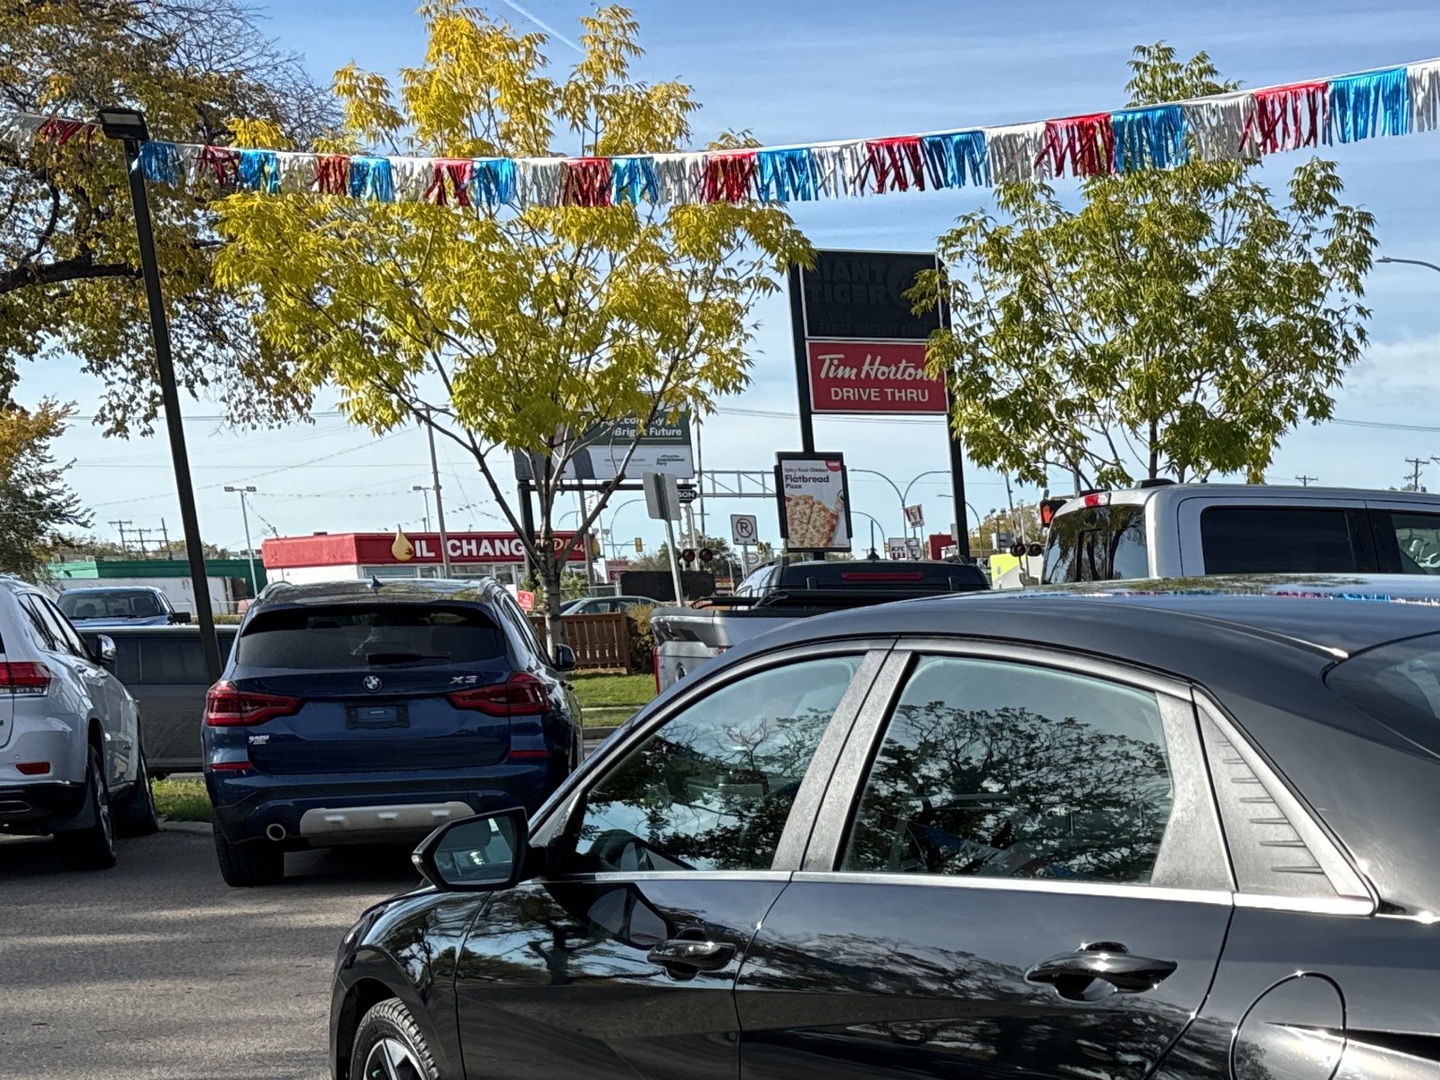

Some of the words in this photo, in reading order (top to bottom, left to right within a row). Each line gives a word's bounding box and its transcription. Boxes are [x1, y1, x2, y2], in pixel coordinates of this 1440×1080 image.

[806, 284, 888, 305] TIGER
[817, 353, 857, 380] Tim
[830, 387, 880, 400] DRIVE
[884, 388, 929, 402] THRU
[614, 428, 647, 438] Brigt
[649, 427, 682, 436] Future
[784, 475, 830, 483] Flatbread
[447, 538, 542, 558] CHANG
[449, 675, 478, 684] X3
